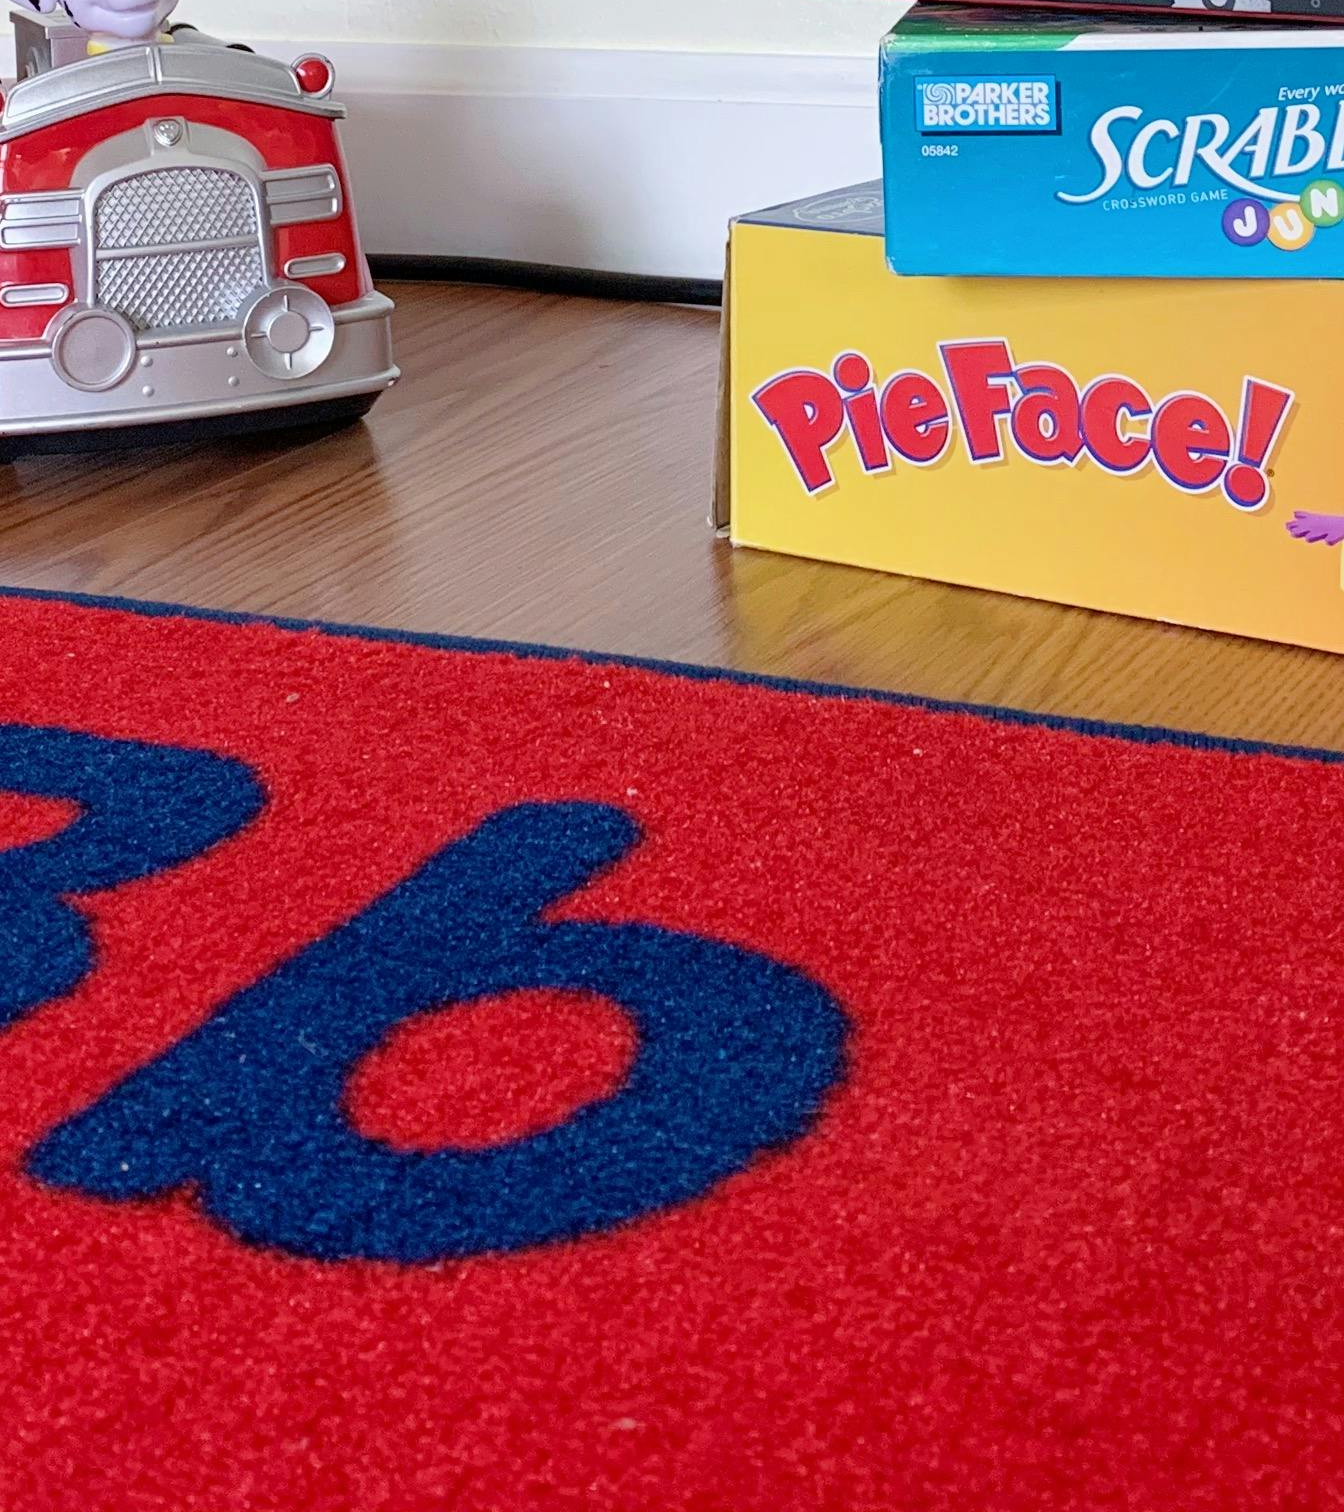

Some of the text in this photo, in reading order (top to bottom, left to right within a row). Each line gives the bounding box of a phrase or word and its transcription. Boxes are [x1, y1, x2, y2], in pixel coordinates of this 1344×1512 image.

[955, 82, 1050, 104] PARKER
[1277, 86, 1321, 102] Every
[923, 103, 1051, 126] BROTHERS
[921, 145, 959, 156] 05842
[1190, 188, 1229, 203] GAME
